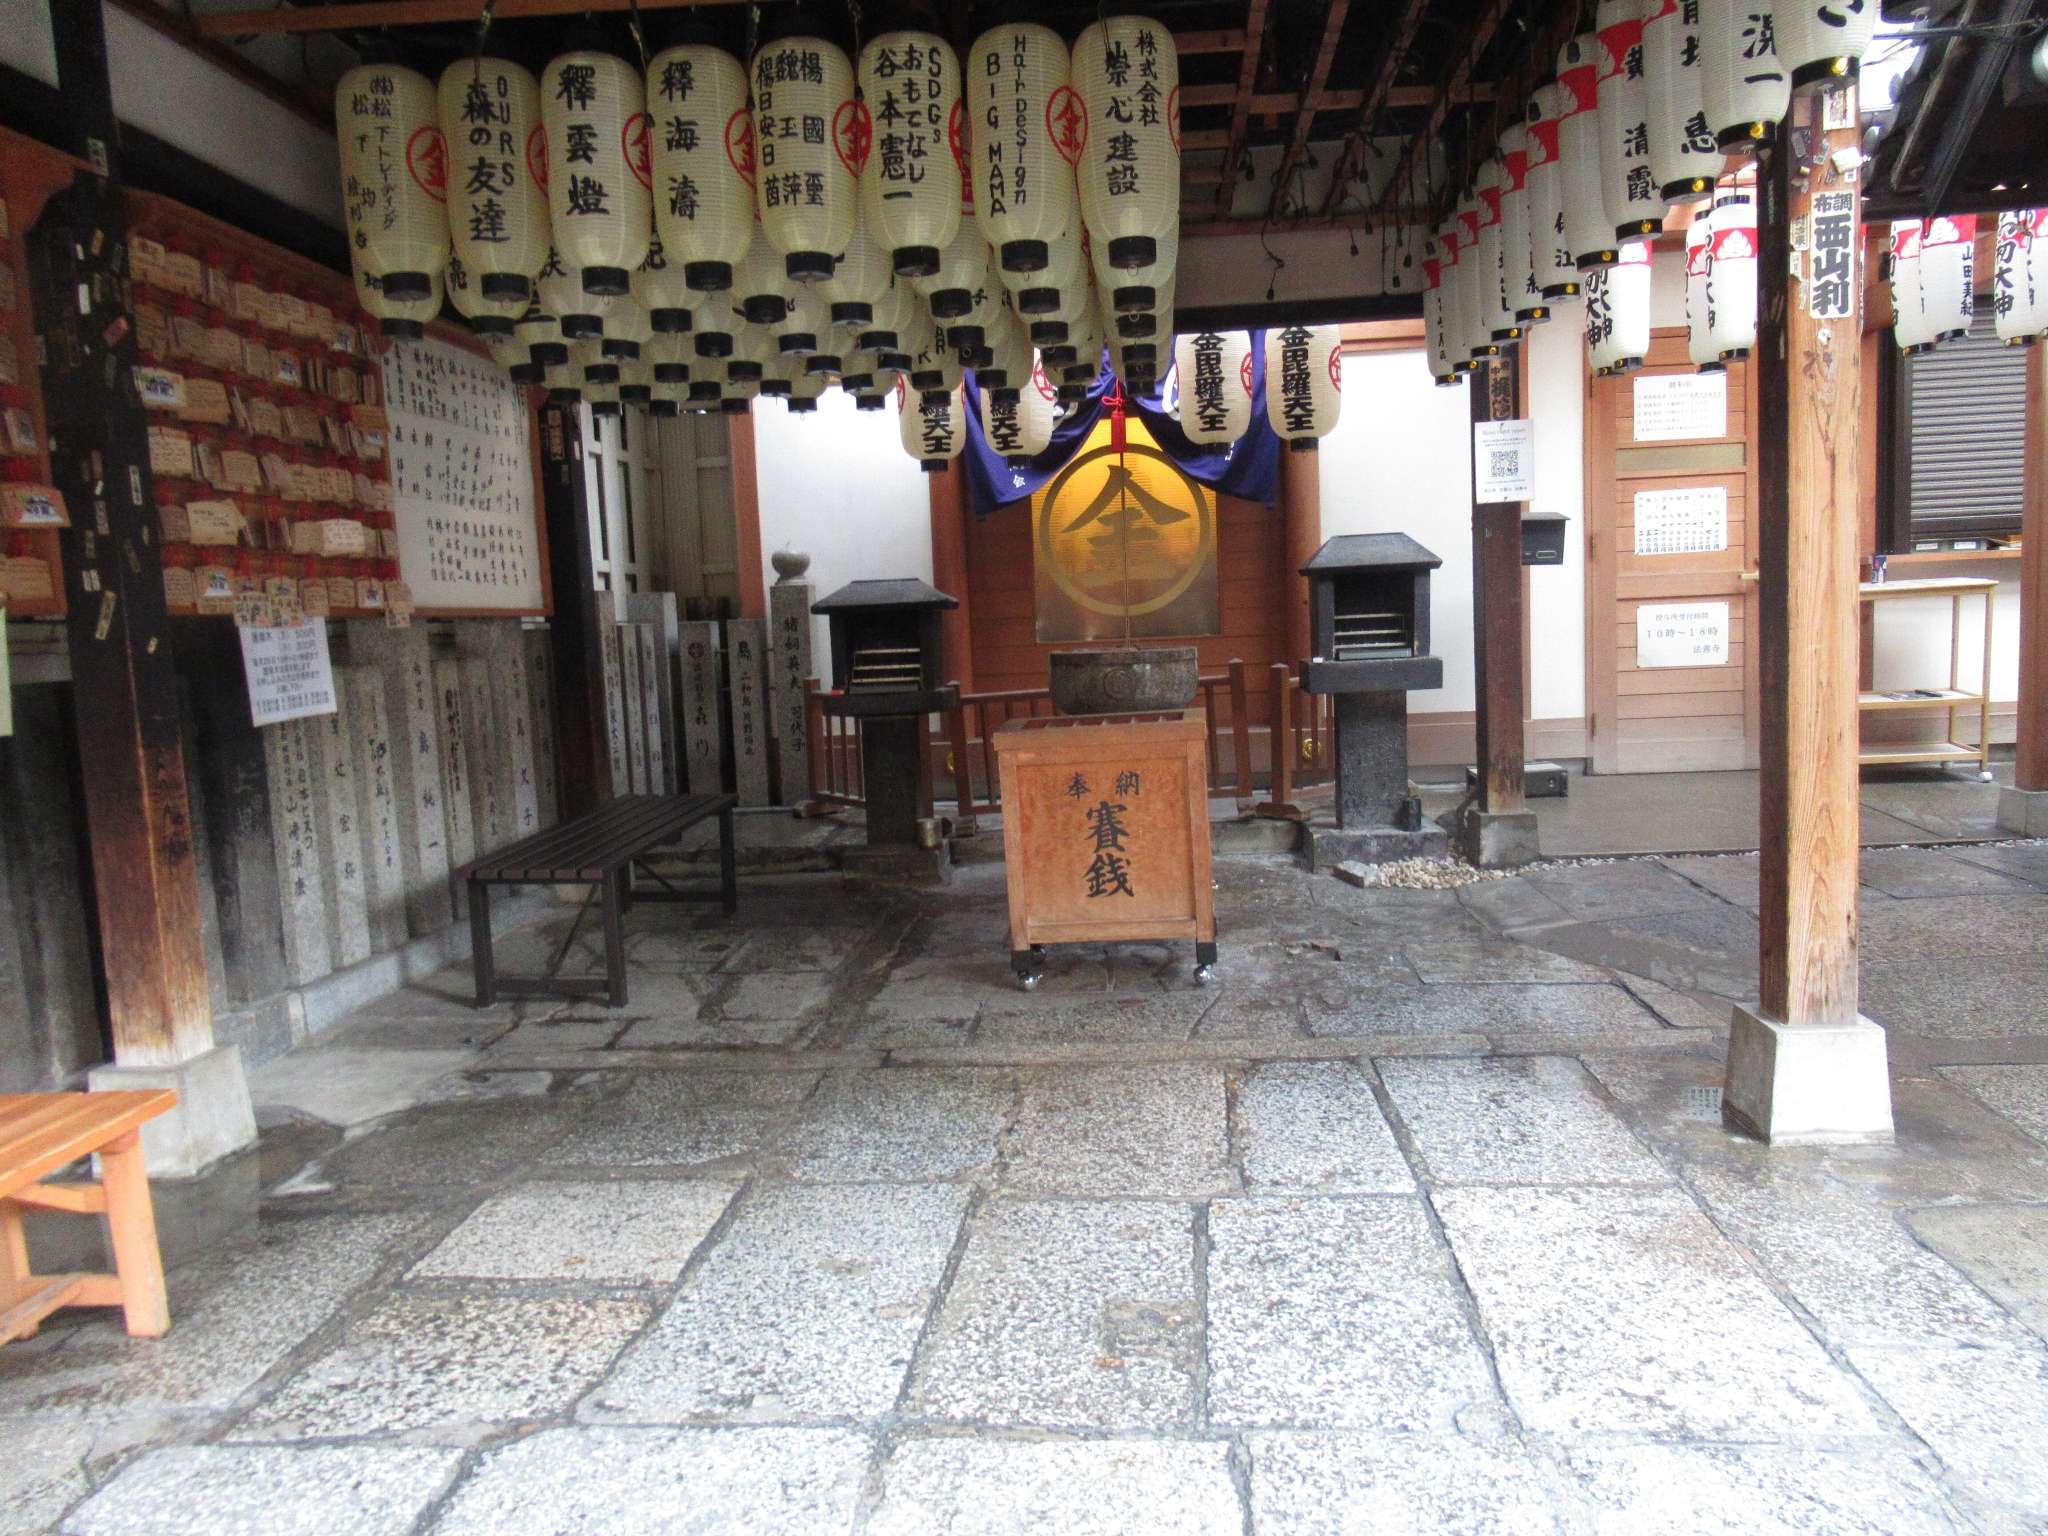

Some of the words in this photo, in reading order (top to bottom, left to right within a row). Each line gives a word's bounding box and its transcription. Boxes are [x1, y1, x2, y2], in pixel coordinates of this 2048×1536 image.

[873, 48, 913, 199] 谷本憲一
[902, 43, 928, 183] おもてなし
[927, 47, 942, 144] SDGs
[986, 53, 1000, 131] BIG
[1135, 29, 1162, 127] 株式会社
[462, 83, 511, 243] 森の友達
[497, 75, 515, 186] OURS
[988, 143, 1008, 218] MAMA
[1812, 213, 1852, 316] 西山利
[1082, 800, 1134, 898] 賽銭
